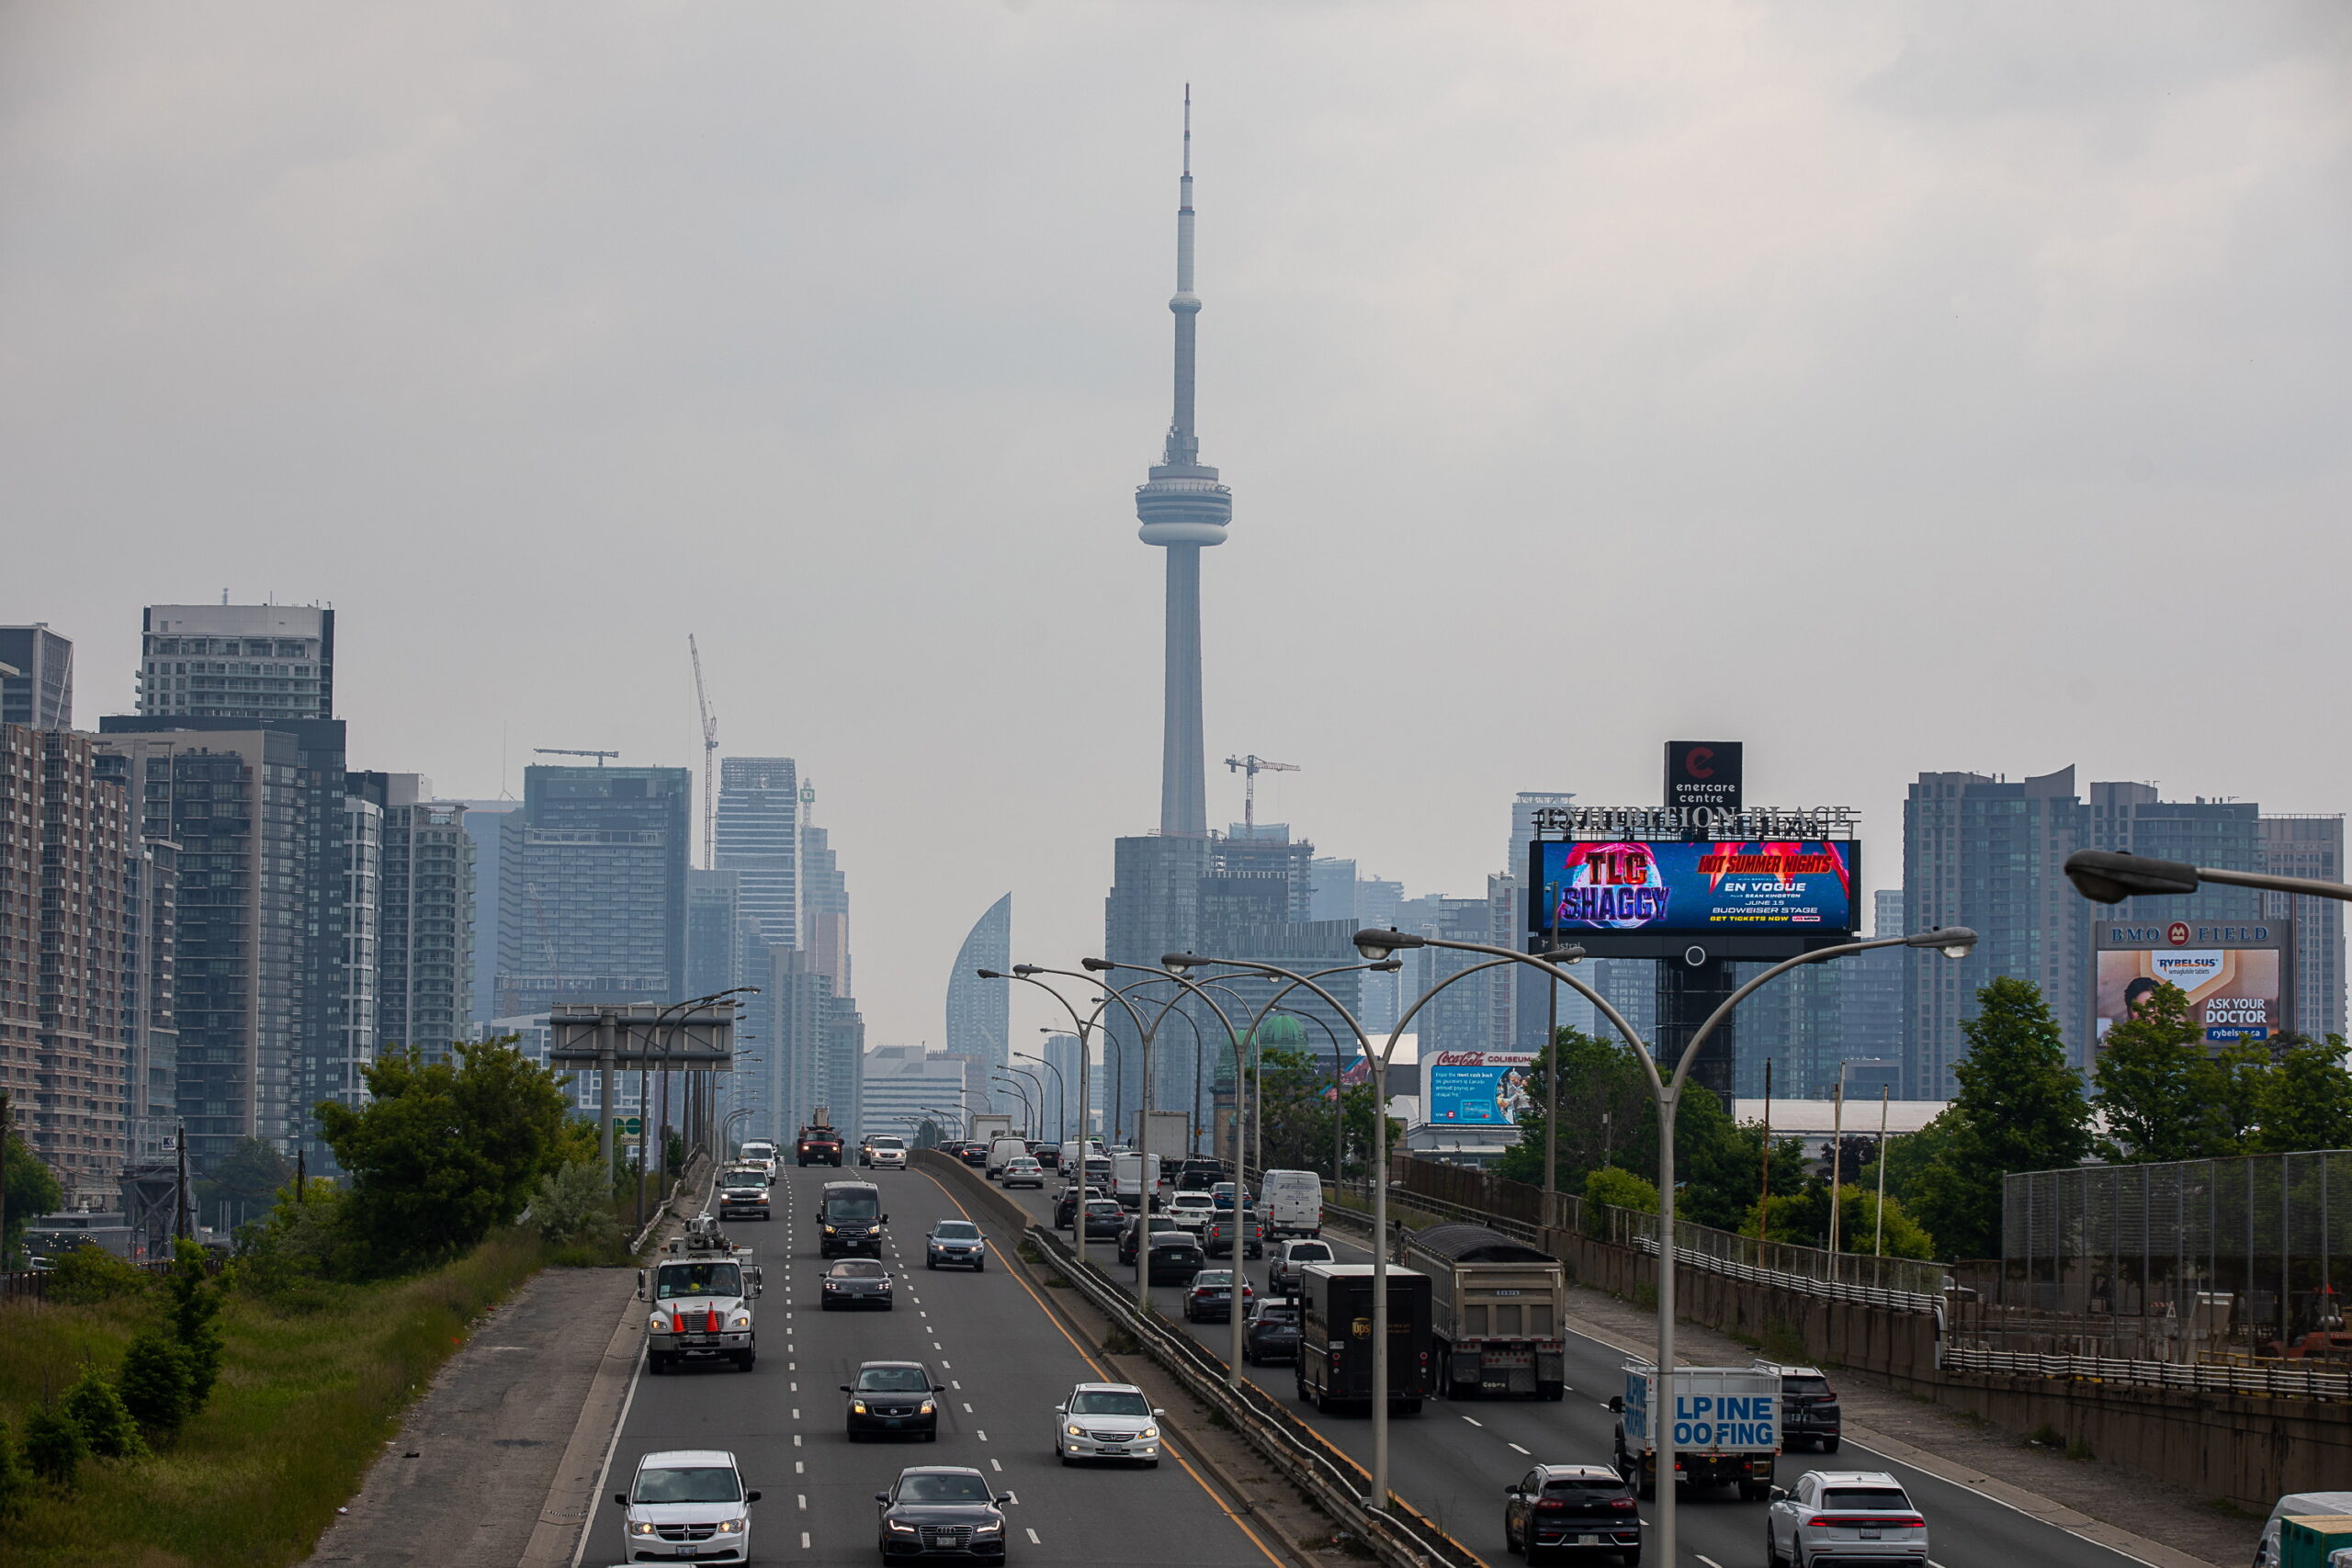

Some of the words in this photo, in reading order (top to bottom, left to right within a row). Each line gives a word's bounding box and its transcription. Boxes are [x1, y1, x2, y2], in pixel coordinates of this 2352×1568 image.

[1676, 784, 1736, 793] enercare
[1679, 793, 1724, 803] centre
[1542, 806, 1737, 828] EXHIBITION
[1749, 806, 1851, 828] PLACE
[1585, 852, 1648, 885] TLC
[1697, 855, 1726, 874] HOT
[1726, 855, 1781, 874] SUMMER
[1781, 855, 1833, 874] NIGHTS
[1724, 883, 1746, 892] EN
[1752, 883, 1806, 892] VOGUE
[1563, 886, 1671, 920] SHAGGY
[2110, 927, 2161, 942] BMO
[2197, 926, 2269, 942] FIELD
[2207, 998, 2231, 1009] ASK
[2232, 998, 2266, 1009] YOUR
[2206, 1010, 2267, 1023] DOCTOR
[1437, 1051, 1487, 1066] Coca-Cola
[1673, 1396, 1773, 1420] LPINE
[1673, 1422, 1773, 1445] OOFING
